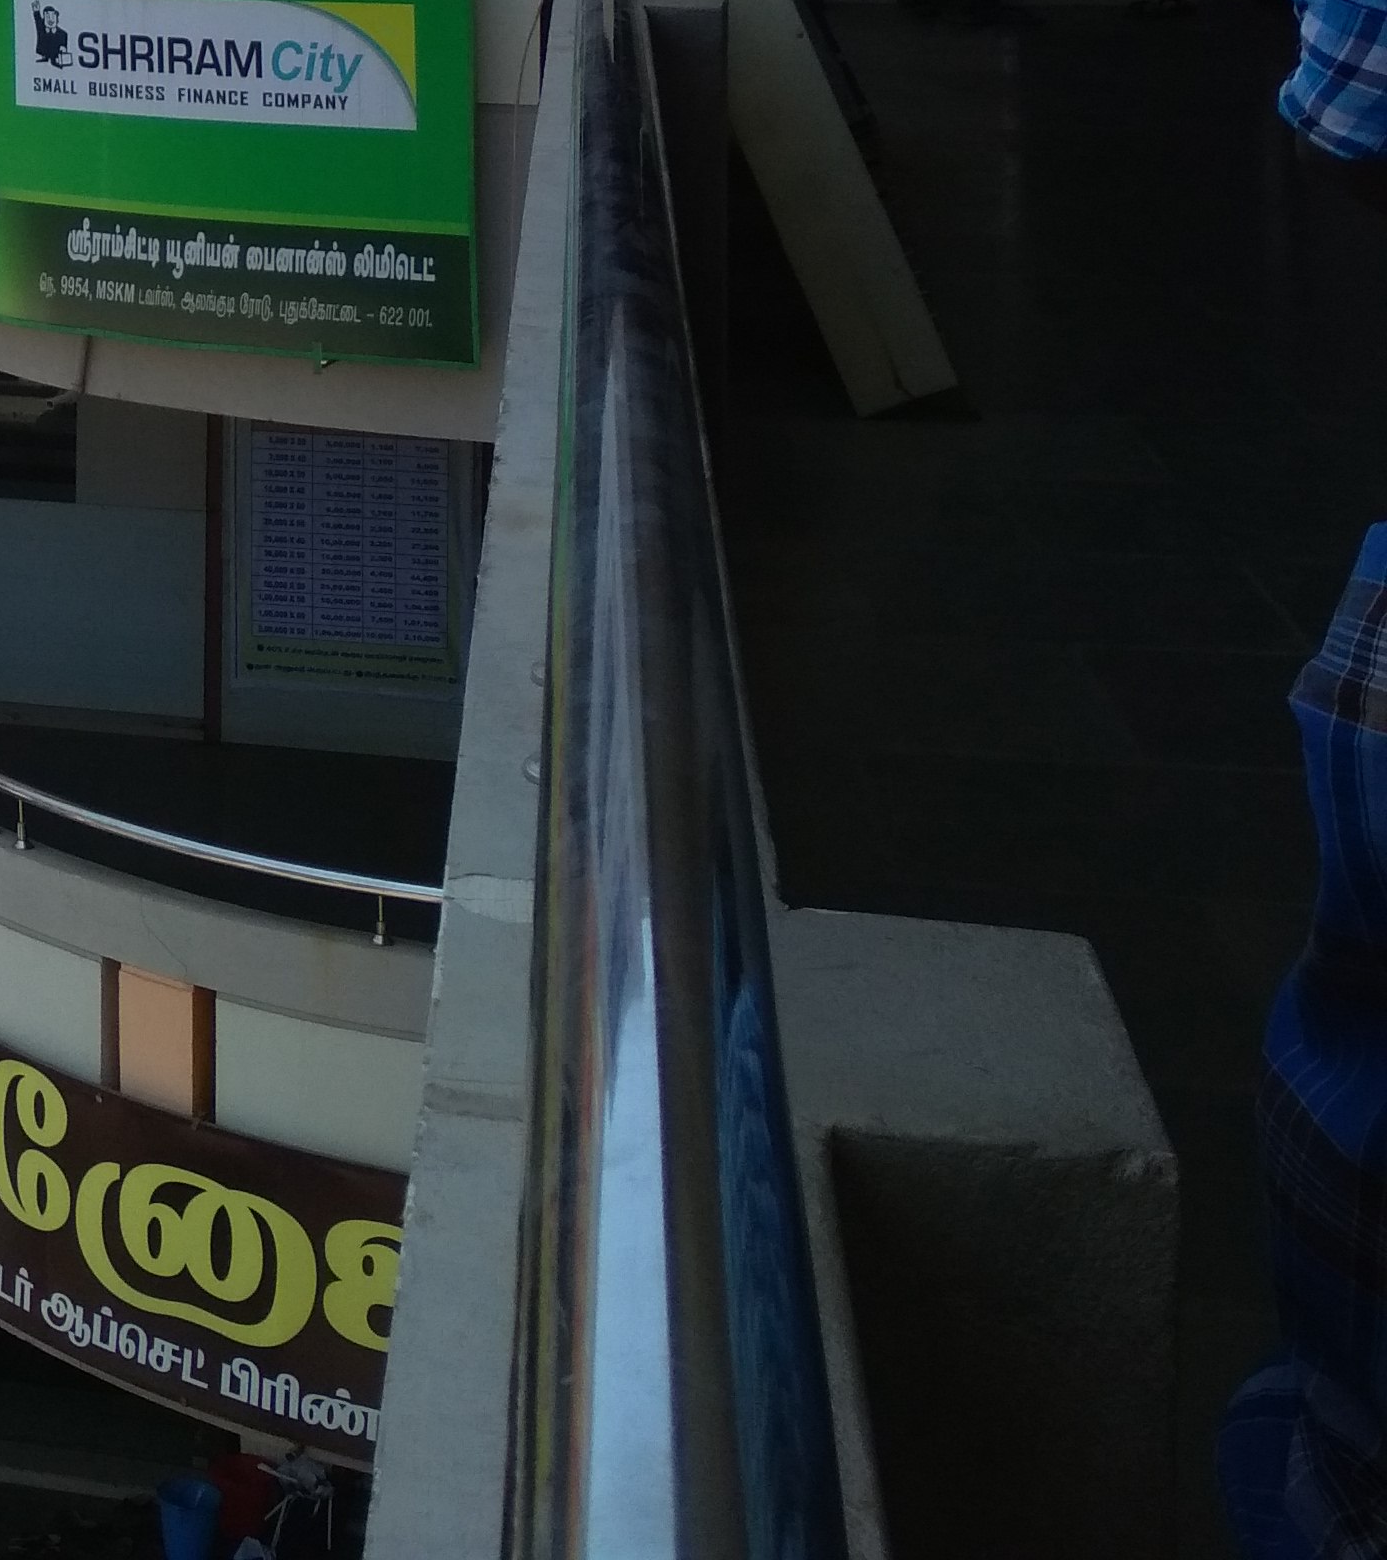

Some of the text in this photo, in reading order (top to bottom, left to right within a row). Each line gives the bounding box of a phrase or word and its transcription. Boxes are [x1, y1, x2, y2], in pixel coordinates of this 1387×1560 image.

[77, 31, 362, 94] SHRIRAM City
[33, 77, 348, 111] SMALL BUSINESS FINANCE COMPANY
[61, 276, 403, 326] 9954, MSKM 622
